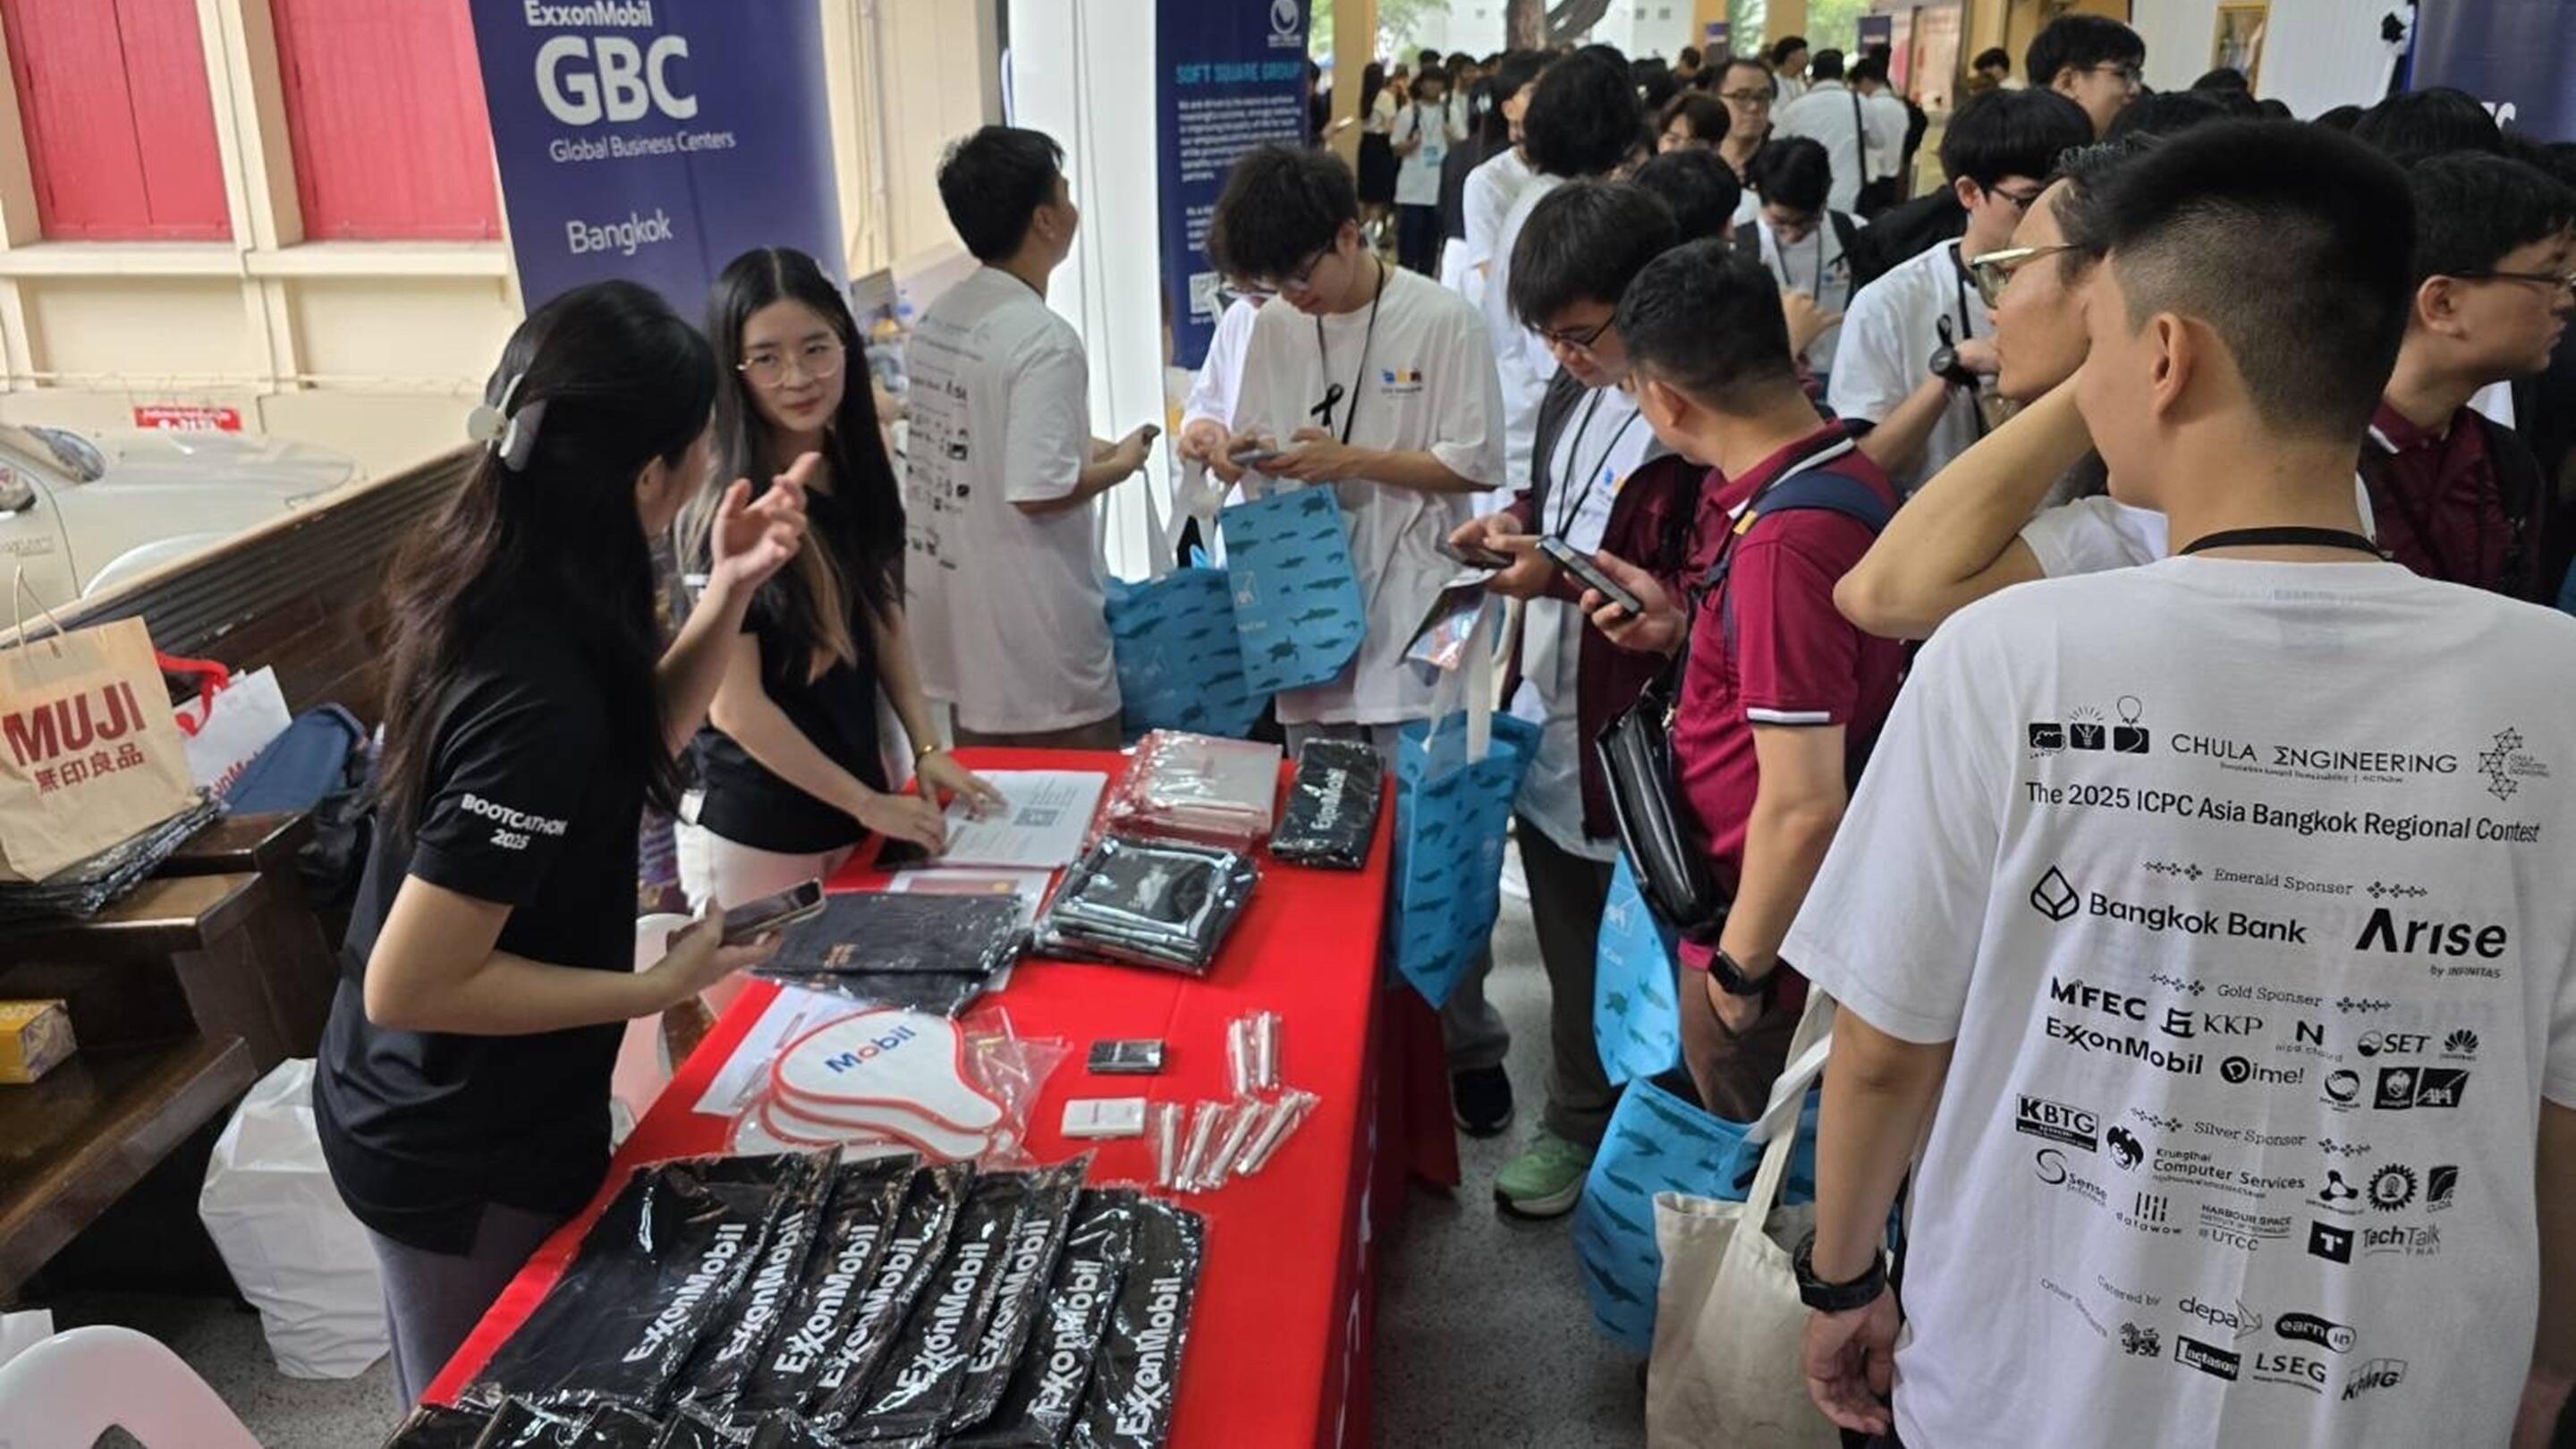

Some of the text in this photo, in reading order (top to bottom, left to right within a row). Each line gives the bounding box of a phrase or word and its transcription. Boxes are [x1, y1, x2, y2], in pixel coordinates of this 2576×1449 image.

[523, 0, 654, 27] ExxonMobil
[534, 35, 699, 125] GBC
[549, 131, 736, 162] Global Business Centers
[566, 208, 673, 256] Bangkok
[2, 682, 146, 767] MUJI
[34, 741, 146, 794] 無印良品
[2171, 733, 2258, 761] CHULA
[461, 792, 568, 835] BOOTCATHON
[2025, 782, 2540, 843] The 2025 ICPC Asia Bangkok Regional Contest
[490, 828, 530, 850] 2025
[2214, 868, 2279, 887] Emerald
[2089, 891, 2308, 945] Bangkok Bank
[2354, 908, 2507, 958] Arise
[2217, 984, 2252, 1000] Gold
[2429, 964, 2502, 979] by INFINITAS
[2050, 975, 2147, 1021] MFEC
[2046, 1016, 2204, 1075] ExxonMobil
[2203, 1012, 2264, 1036] KKP
[2383, 1032, 2432, 1054] SET
[824, 1025, 917, 1073] Mobil
[2020, 1097, 2096, 1134] KBTG
[2193, 1120, 2241, 1141] Silver
[2153, 1158, 2233, 1182] Computer
[2239, 1172, 2306, 1190] Services
[2156, 1148, 2212, 1163] Krungthai
[2115, 1211, 2182, 1234] datawow
[622, 1223, 748, 1363] ExxonMobil
[716, 1209, 805, 1362] ExxonMobil
[772, 1224, 880, 1374] ExxonMobil
[967, 1219, 1051, 1373] ExxonMobil
[818, 1238, 922, 1387] ExxonMobil
[896, 1242, 990, 1387] ExxonMobil
[2179, 1297, 2238, 1328] depa
[2280, 1319, 2351, 1344] earn in
[1115, 1276, 1182, 1436] ExxonMobil
[2255, 1352, 2326, 1384] LSEG
